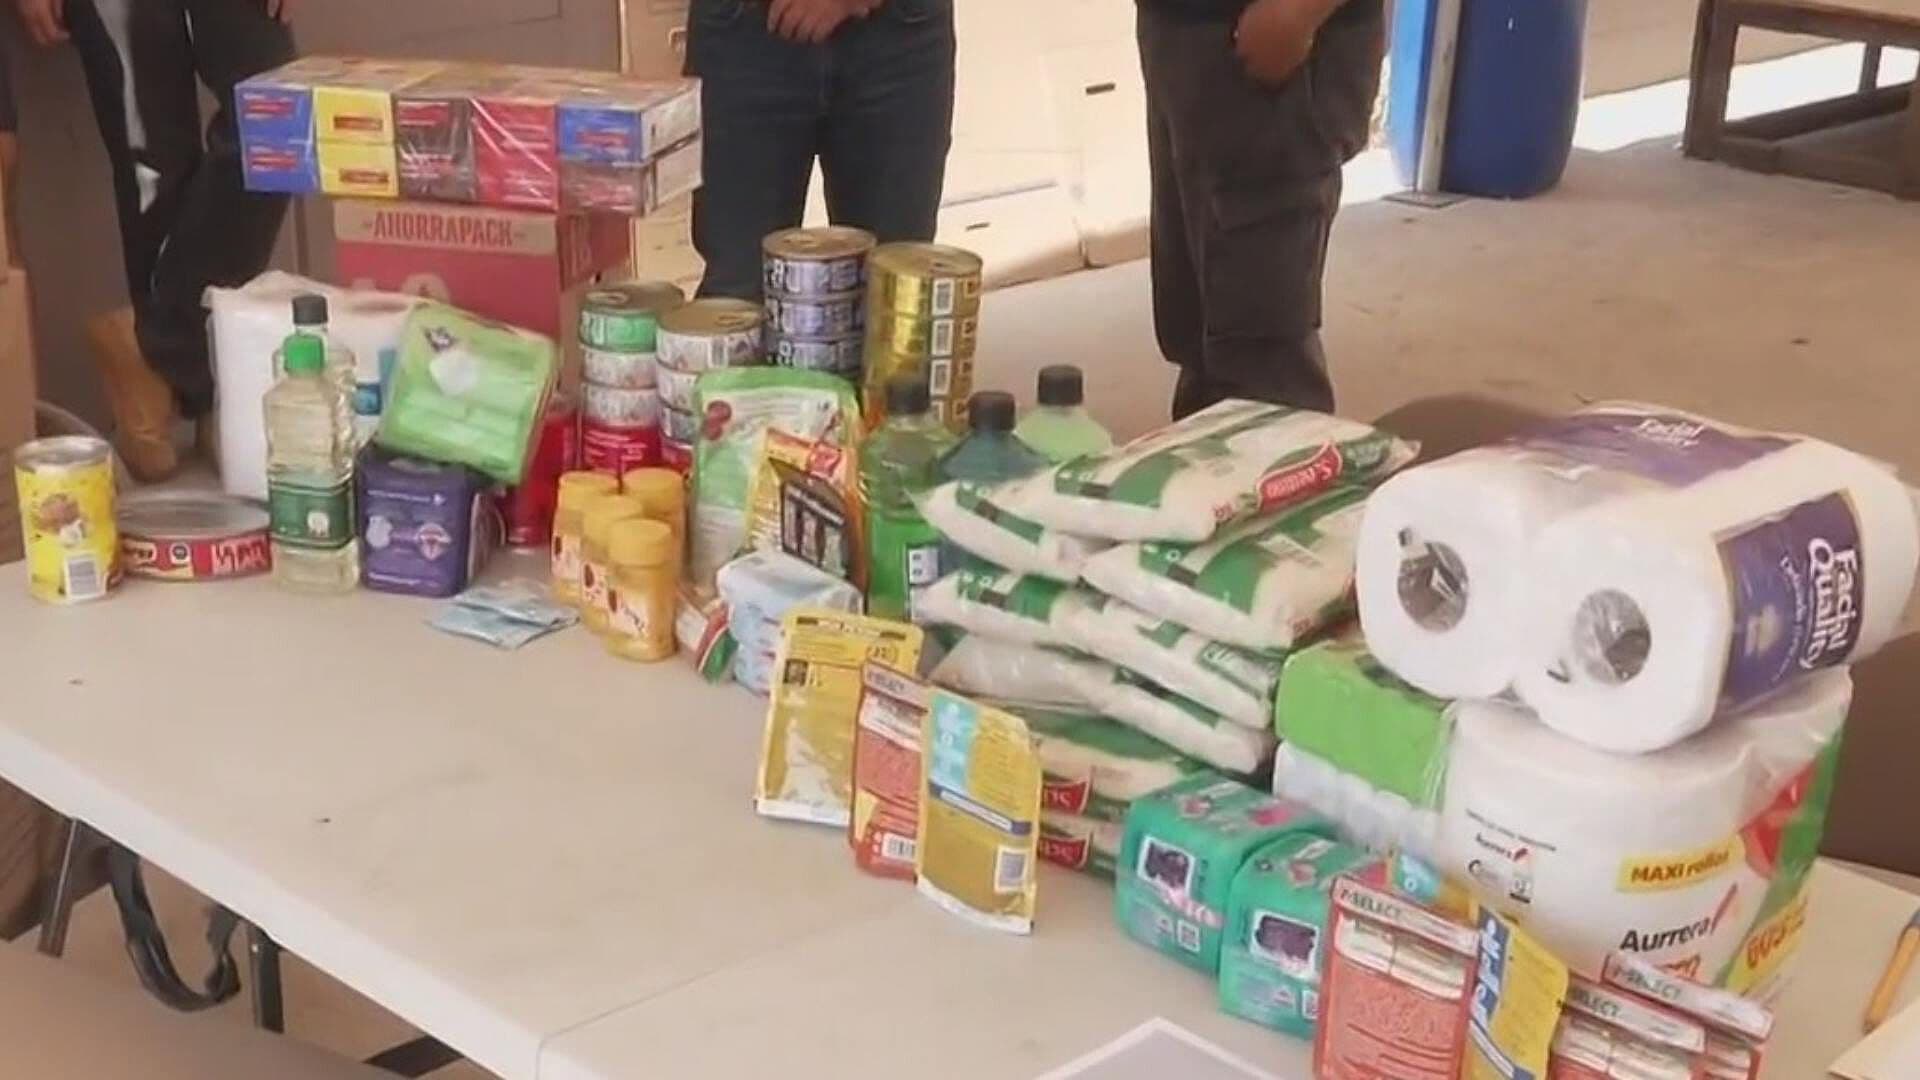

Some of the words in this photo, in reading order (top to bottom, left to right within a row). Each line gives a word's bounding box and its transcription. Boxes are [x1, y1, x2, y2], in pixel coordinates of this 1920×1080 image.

[1799, 537, 1835, 669] Quality
[1827, 550, 1857, 651] Facial
[1631, 863, 1685, 883] MAXI
[1619, 917, 1711, 953] Aurrera
